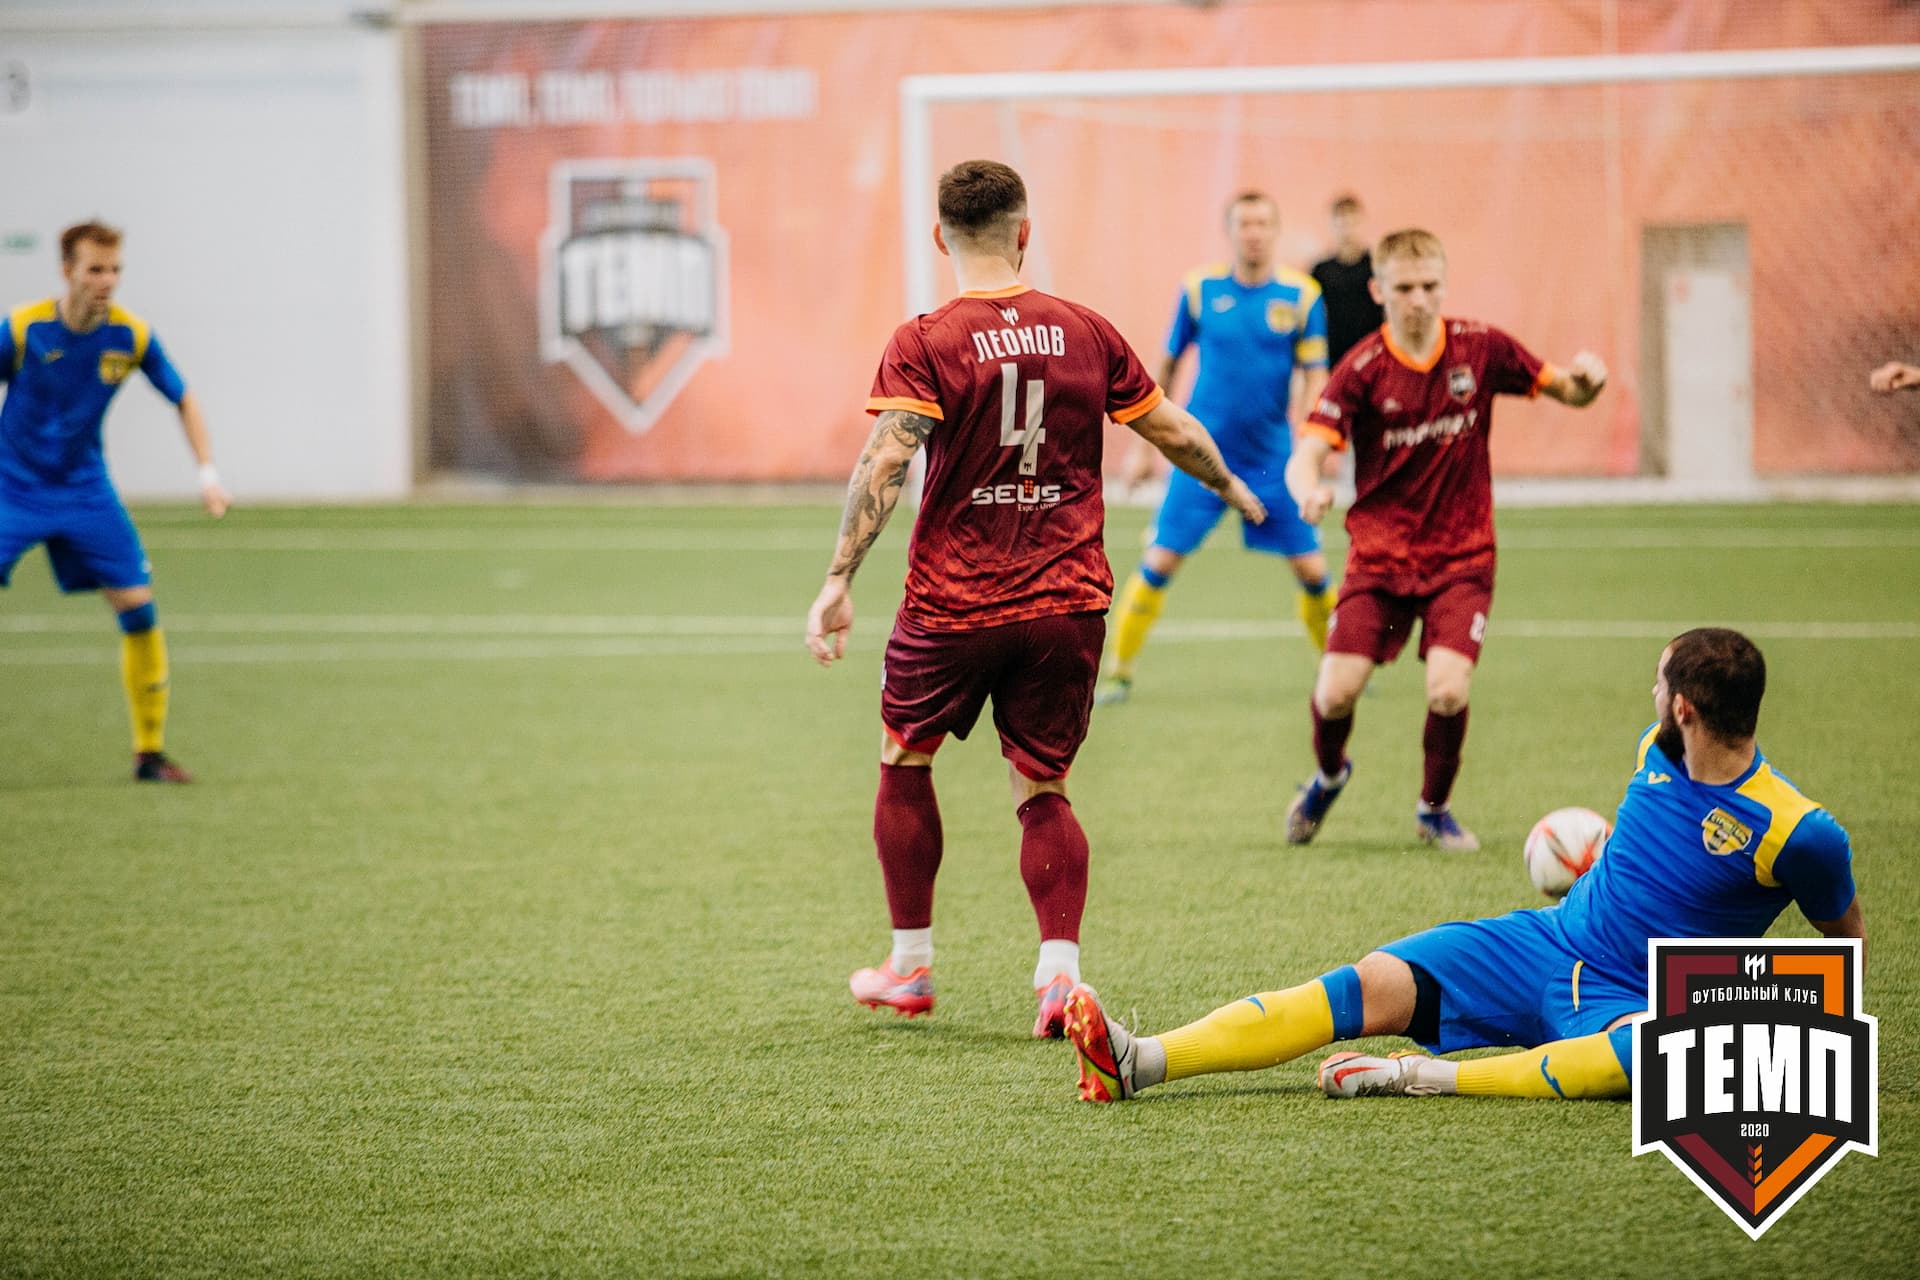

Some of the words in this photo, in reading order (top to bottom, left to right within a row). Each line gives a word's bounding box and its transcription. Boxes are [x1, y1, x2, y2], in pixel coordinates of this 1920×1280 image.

[972, 325, 1065, 363] ЛЕОНОВ
[1000, 362, 1046, 476] 4
[972, 484, 1061, 505] SEUS
